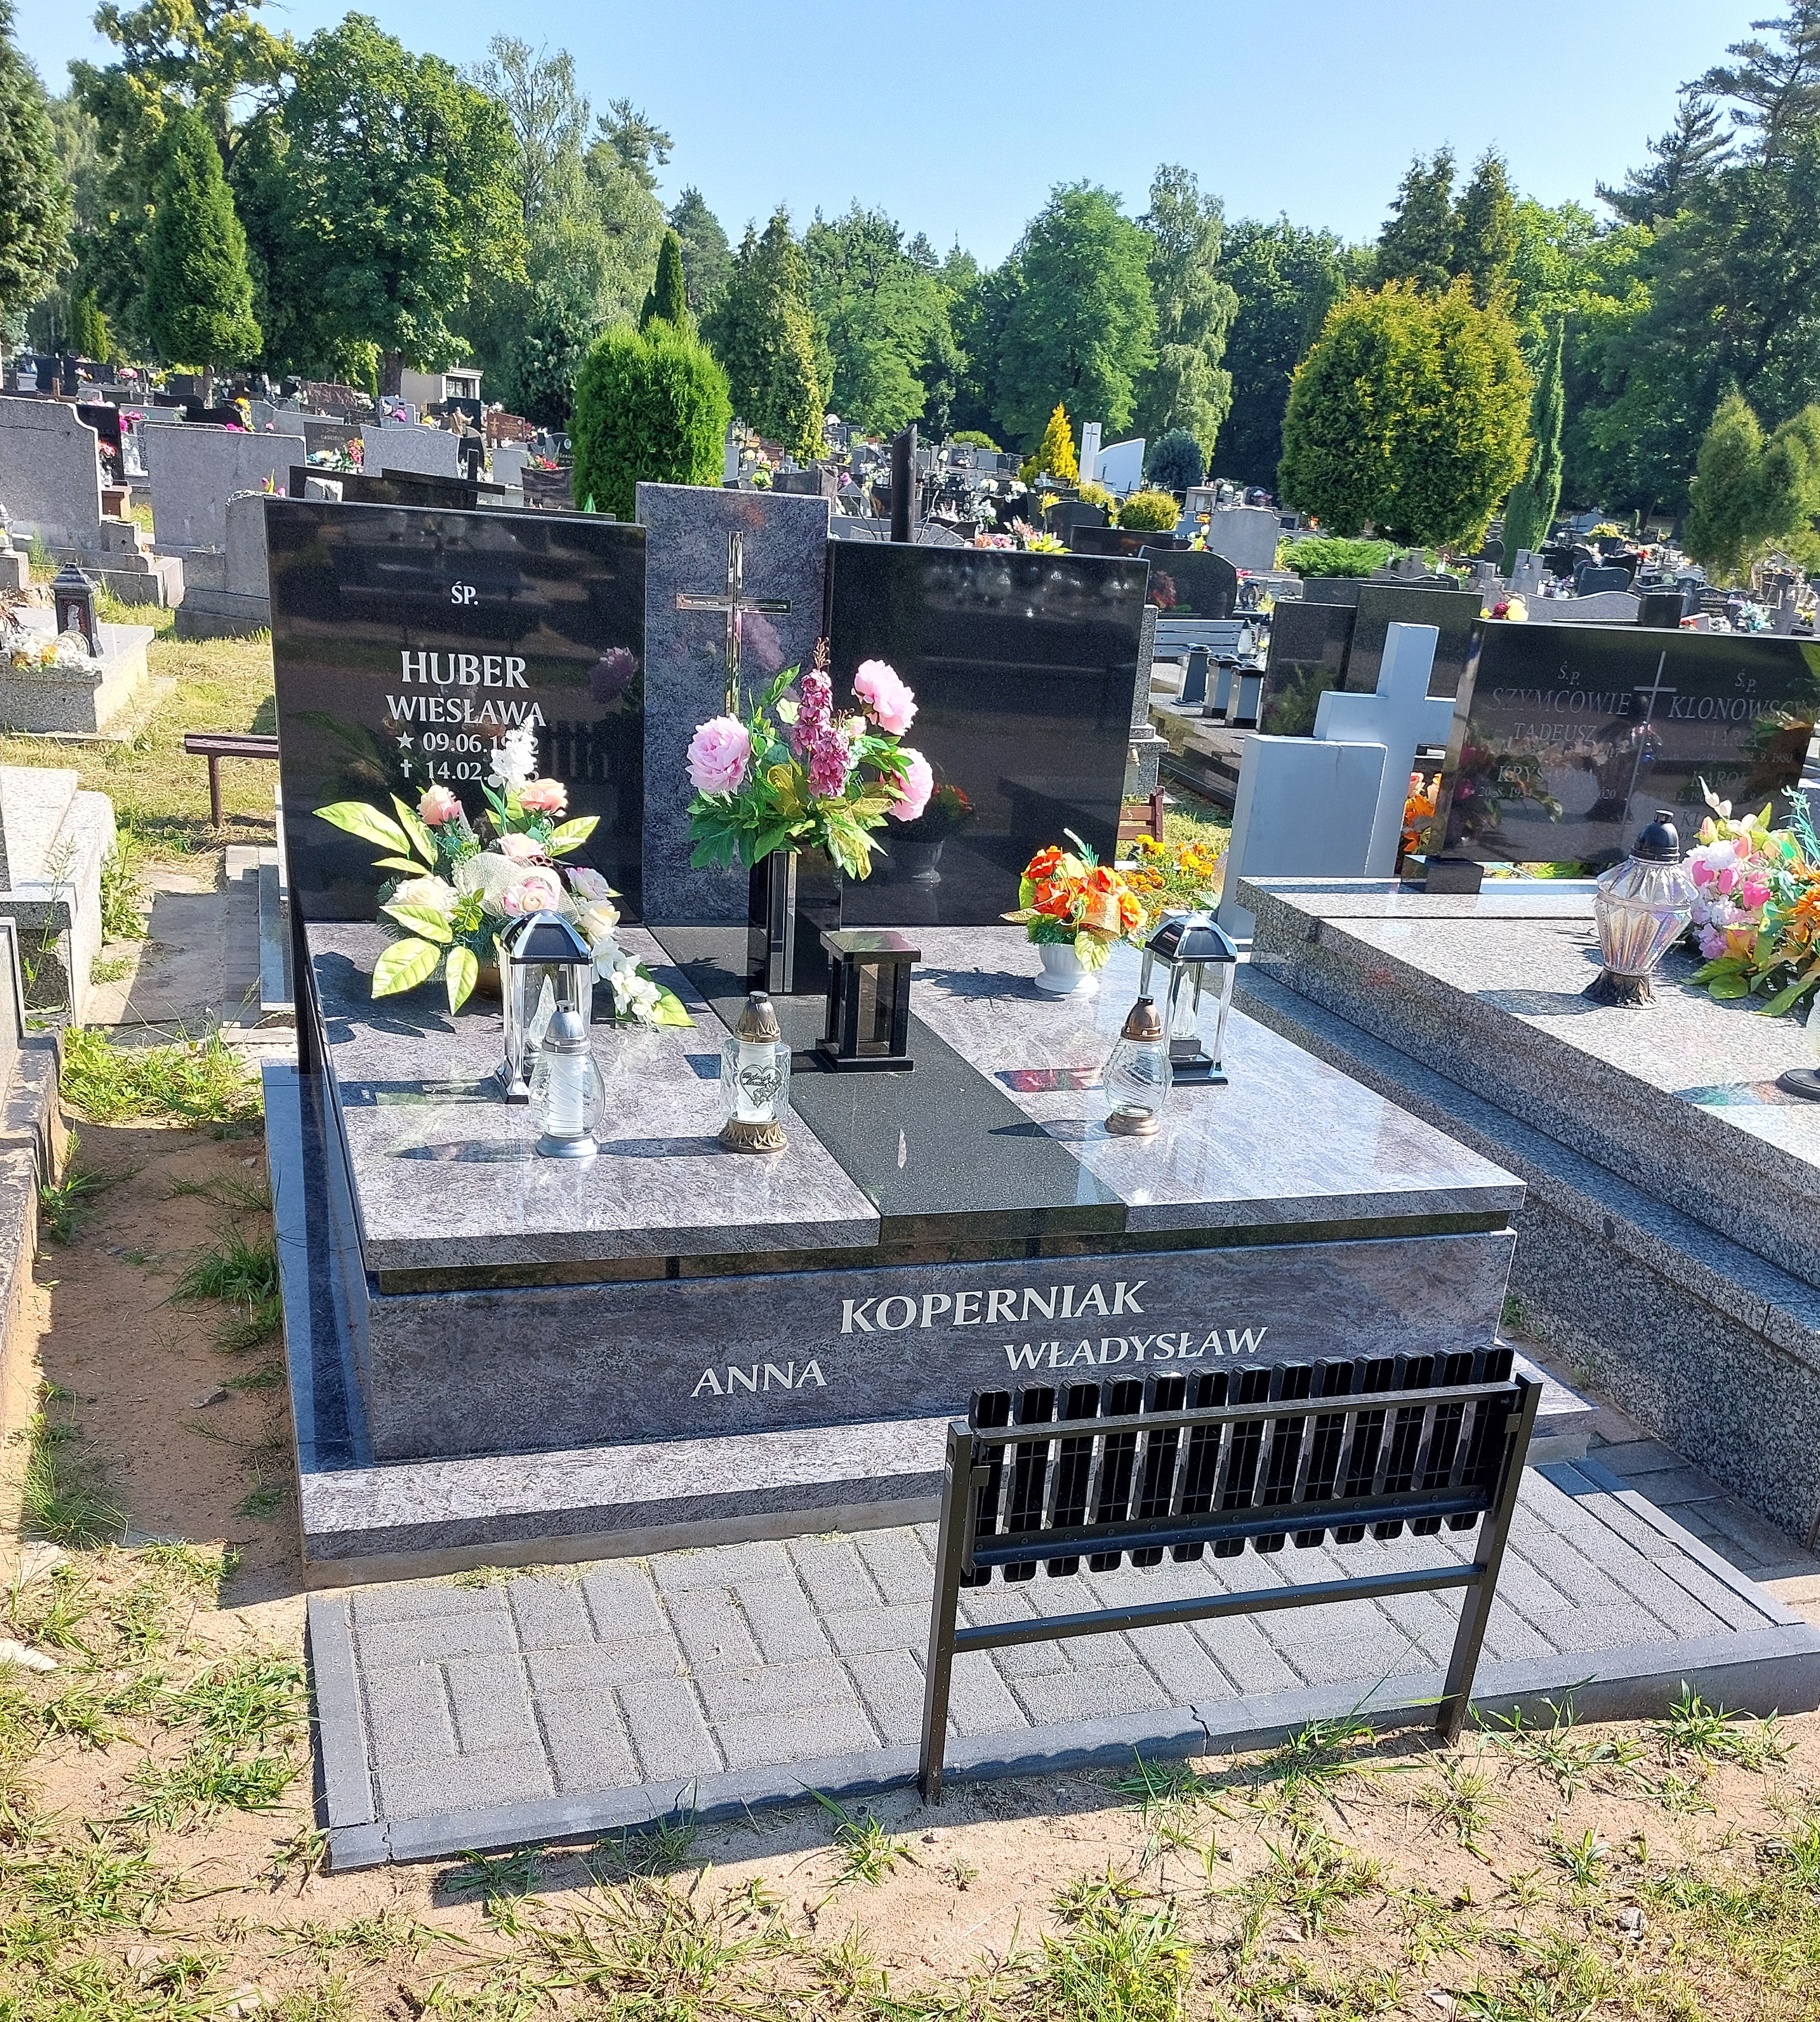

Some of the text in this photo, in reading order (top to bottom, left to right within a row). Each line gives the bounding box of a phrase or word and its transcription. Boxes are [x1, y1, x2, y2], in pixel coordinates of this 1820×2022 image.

[451, 581, 478, 605] ŚP.
[401, 651, 530, 688] HUBER
[385, 694, 547, 727] WIESŁAWA
[1490, 687, 1632, 715] SZYMCOWIE
[423, 732, 539, 754] 09.06.12
[1514, 723, 1596, 745] TADEUSZ
[840, 1280, 1148, 1333] KOPERNIAK
[1003, 1327, 1268, 1371] WŁADYSŁAW
[690, 1359, 828, 1397] ANNA
